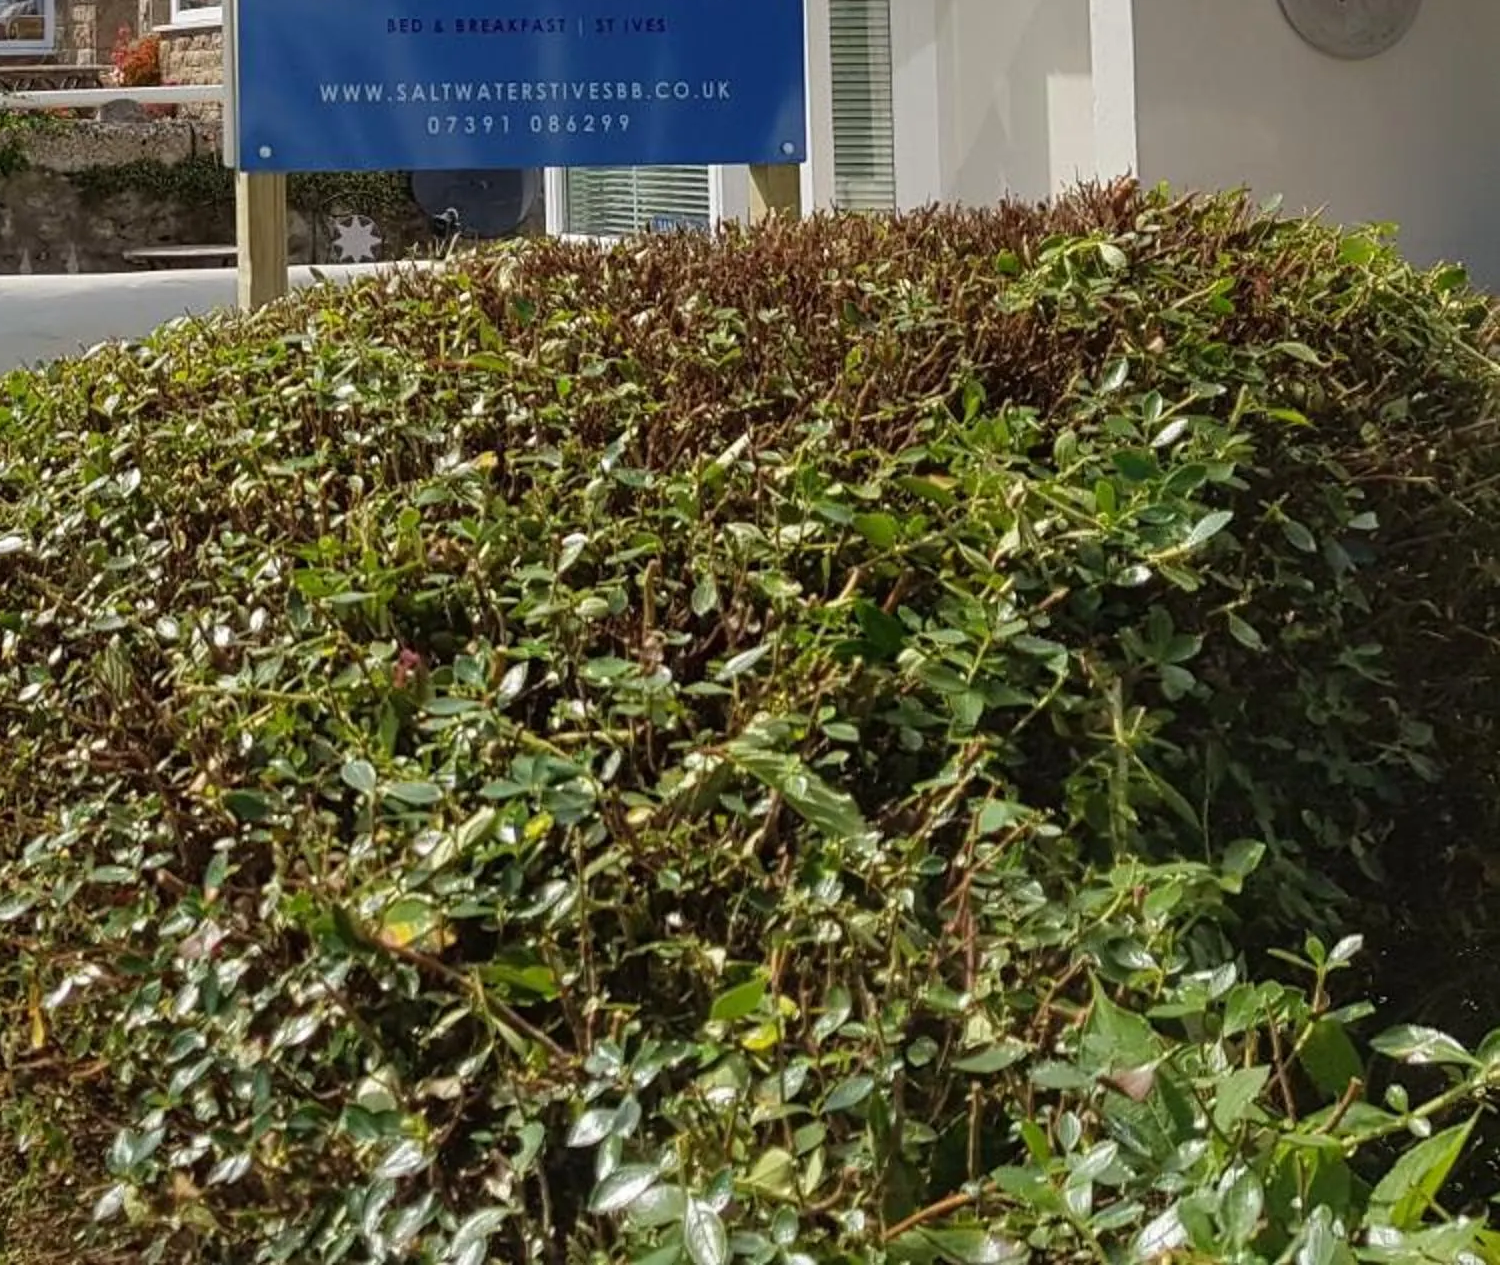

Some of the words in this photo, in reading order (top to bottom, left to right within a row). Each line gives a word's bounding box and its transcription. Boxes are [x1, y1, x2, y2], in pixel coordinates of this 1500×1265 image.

[387, 17, 423, 34] BED
[433, 18, 444, 33] &
[455, 17, 566, 34] BREAKFAST
[595, 17, 615, 33] ST
[624, 17, 666, 33] IVES
[319, 81, 731, 103] WWW.SALTWATERSTIVESBB.CO.UK
[427, 114, 510, 135] 07391
[530, 113, 631, 133] 086299
